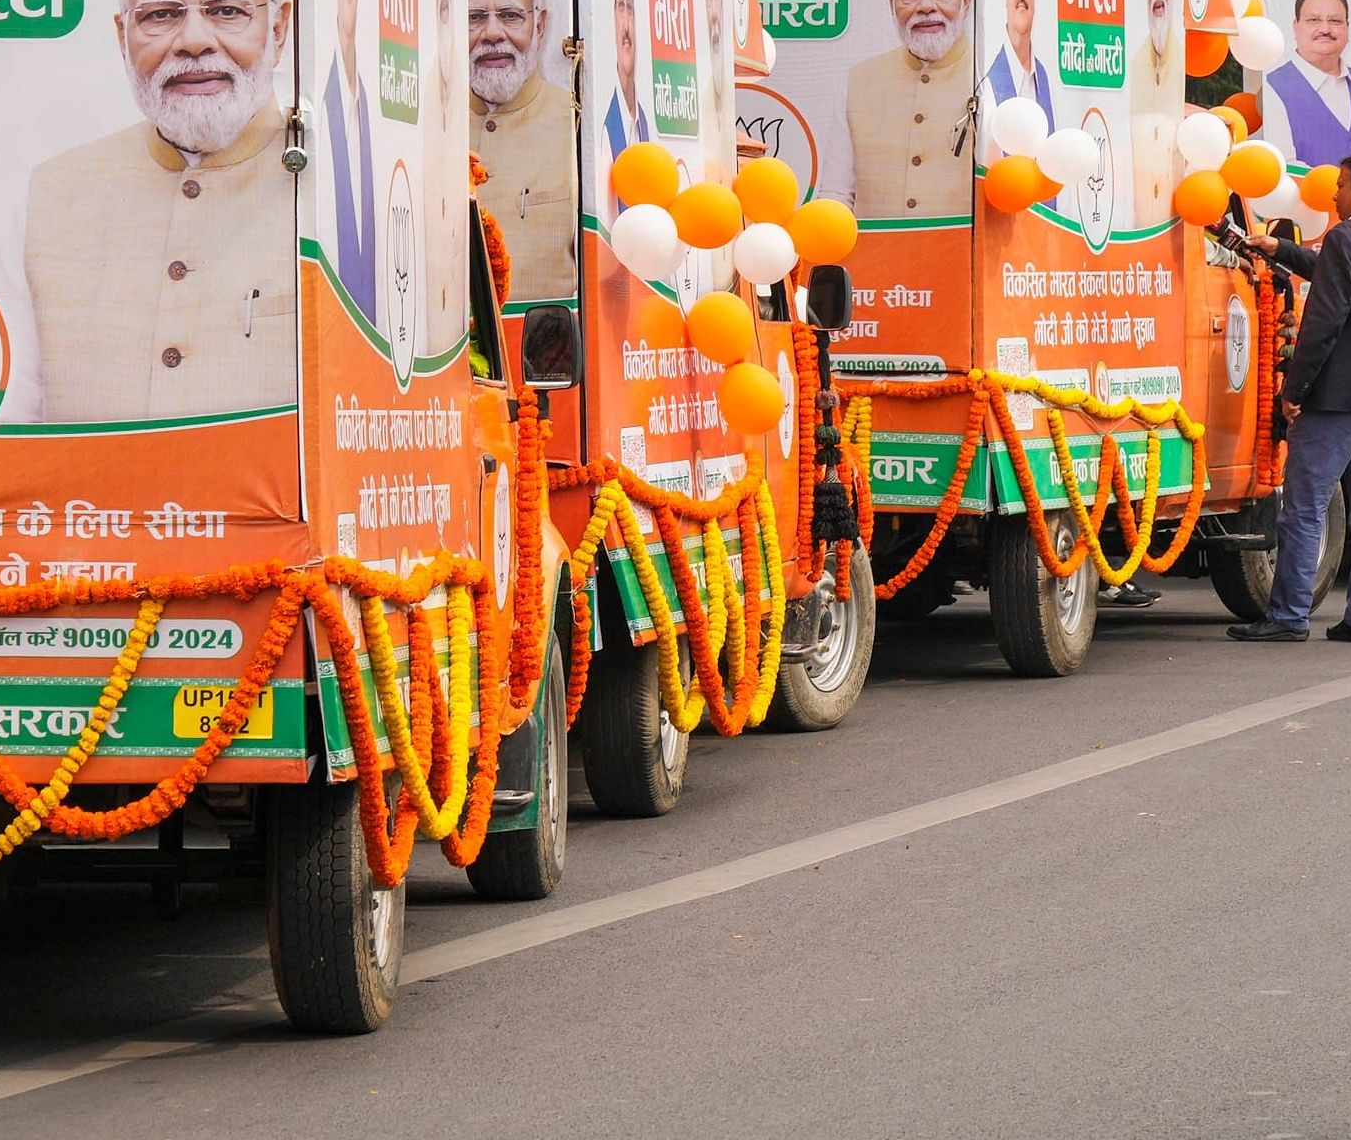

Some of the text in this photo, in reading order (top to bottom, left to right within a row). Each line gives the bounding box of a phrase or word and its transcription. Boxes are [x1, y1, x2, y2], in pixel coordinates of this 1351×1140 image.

[1060, 32, 1123, 77] मोदी गारंटी
[883, 284, 933, 308] सीधा
[1003, 262, 1047, 299] विकसित
[1049, 271, 1075, 297] भारत
[1078, 262, 1108, 298] संकल्प
[1154, 262, 1172, 297] सीधा
[1034, 312, 1058, 347] मोदी
[1061, 311, 1074, 345] जी
[1076, 312, 1089, 344] को
[1111, 311, 1131, 343] अपने
[1133, 317, 1155, 350] सुझाव
[17, 502, 54, 539] के
[65, 499, 133, 540] लिए
[144, 501, 227, 540] सीधा
[26, 626, 58, 647] करें
[168, 630, 233, 649] 2024
